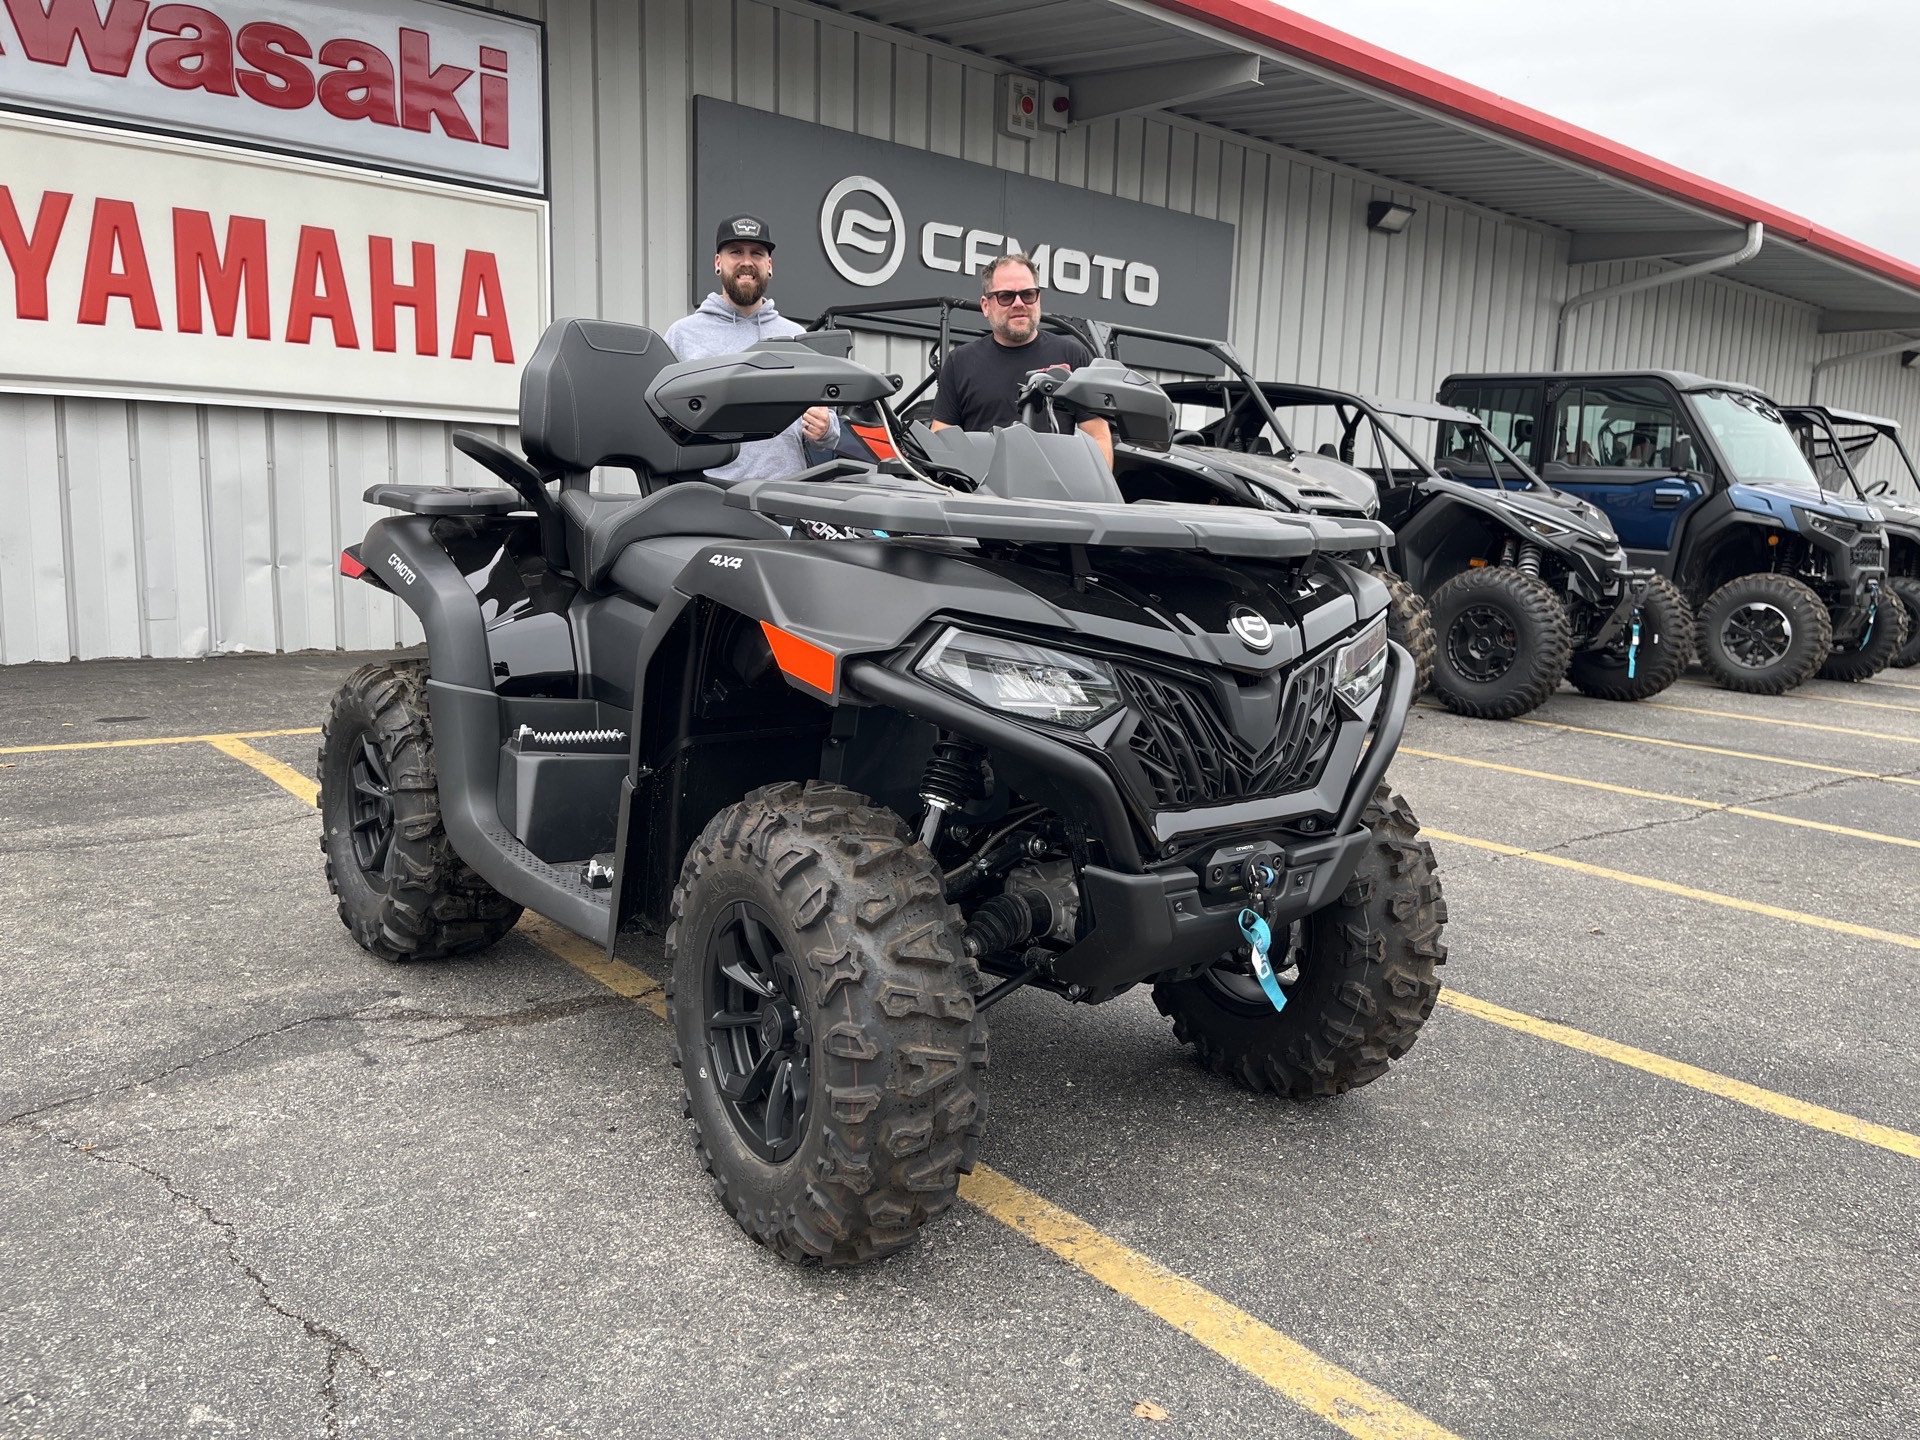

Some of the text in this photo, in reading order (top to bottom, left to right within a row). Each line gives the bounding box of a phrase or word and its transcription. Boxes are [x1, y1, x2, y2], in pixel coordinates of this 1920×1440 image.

[0, 0, 509, 150] wasaki
[0, 185, 515, 364] YAMAHA
[387, 552, 417, 586] CFMOTO
